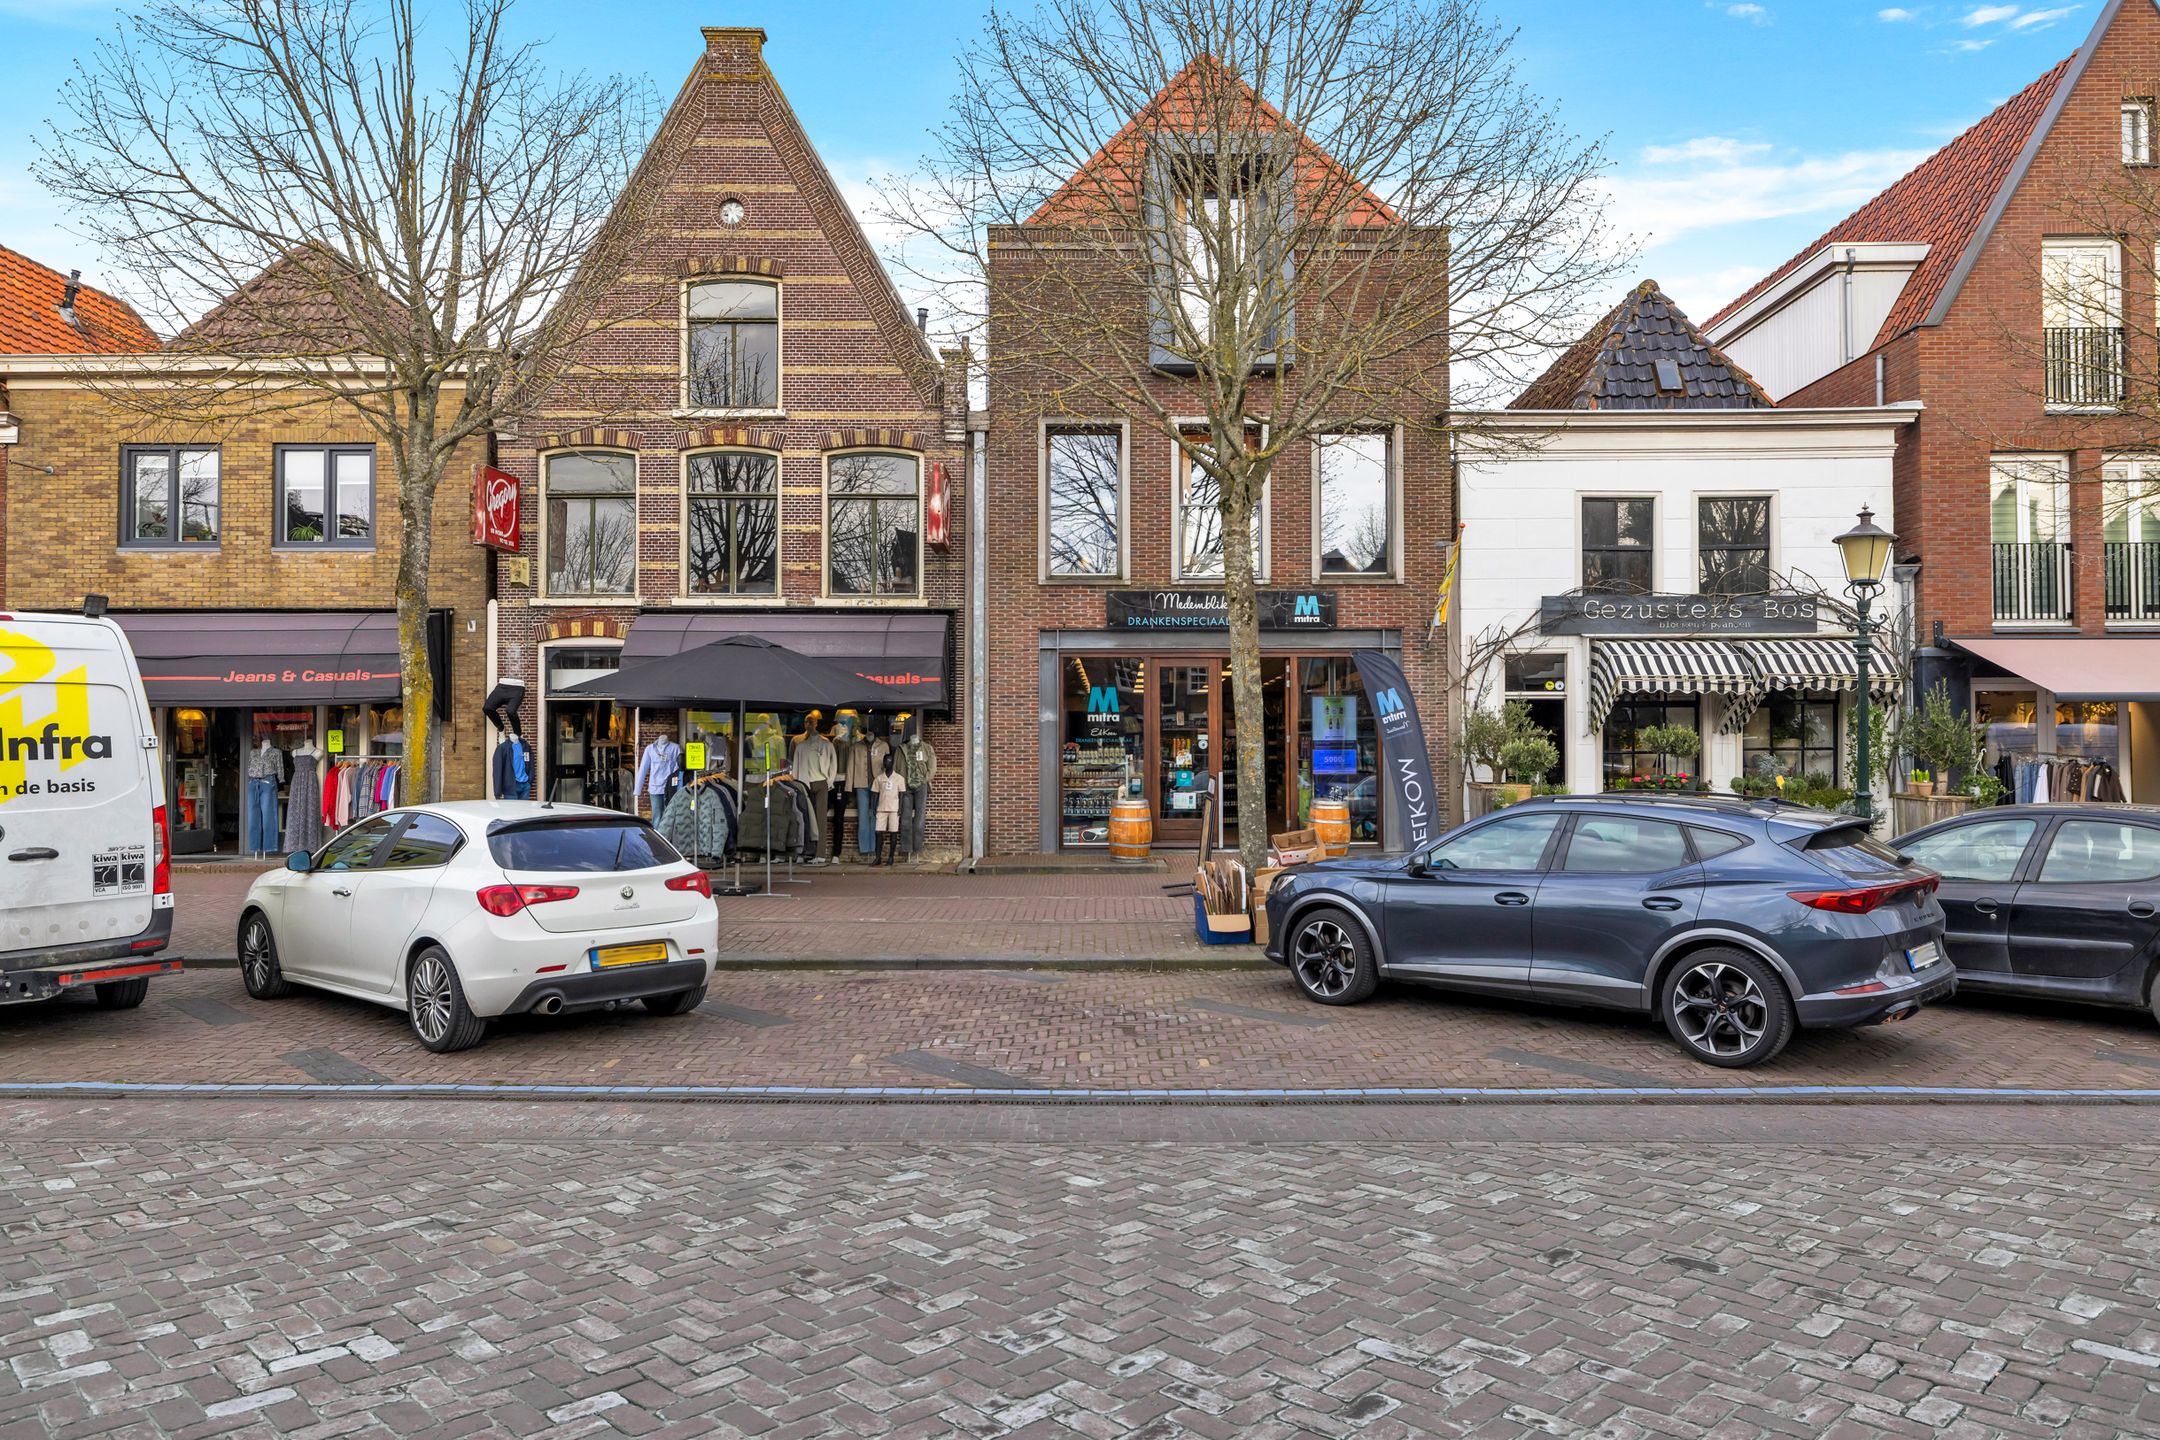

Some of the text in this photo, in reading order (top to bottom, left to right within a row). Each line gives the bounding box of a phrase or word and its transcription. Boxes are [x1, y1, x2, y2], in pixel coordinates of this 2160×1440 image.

[486, 479, 517, 519] Gregory
[1155, 592, 1228, 609] Medemblik
[1583, 599, 1815, 619] Gezusters Bos
[1127, 616, 1231, 626] DRANKENSPECIAAL
[1294, 615, 1320, 623] mitra
[223, 669, 372, 683] Jeans & Casuals
[855, 672, 921, 684] suals
[1087, 712, 1120, 722] mitra
[15, 779, 40, 795] de
[46, 777, 96, 794] basis
[93, 854, 118, 863] kiwa
[121, 852, 144, 861] kiwa
